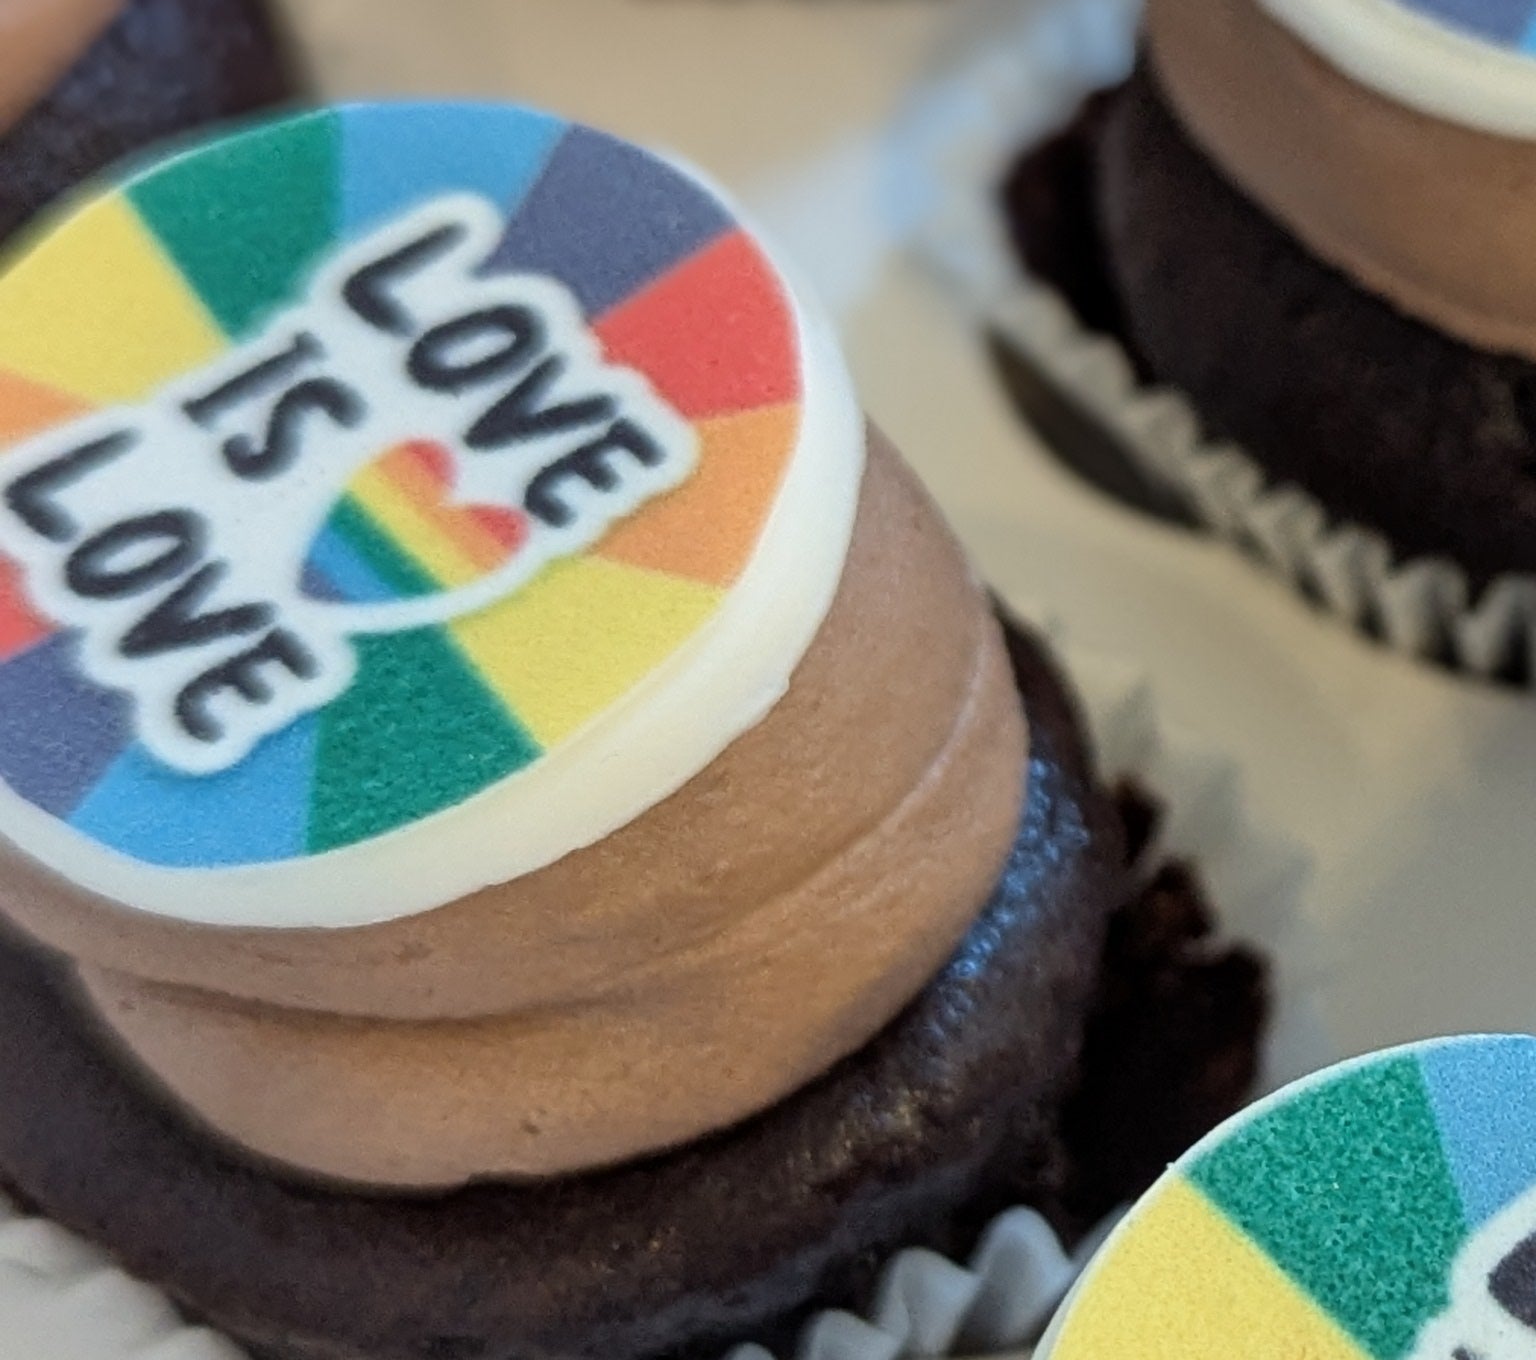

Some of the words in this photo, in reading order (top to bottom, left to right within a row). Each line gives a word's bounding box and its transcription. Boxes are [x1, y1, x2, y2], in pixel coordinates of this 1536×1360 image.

[181, 331, 363, 482] IS
[341, 223, 663, 528] LOVE
[3, 429, 315, 742] LOVE
